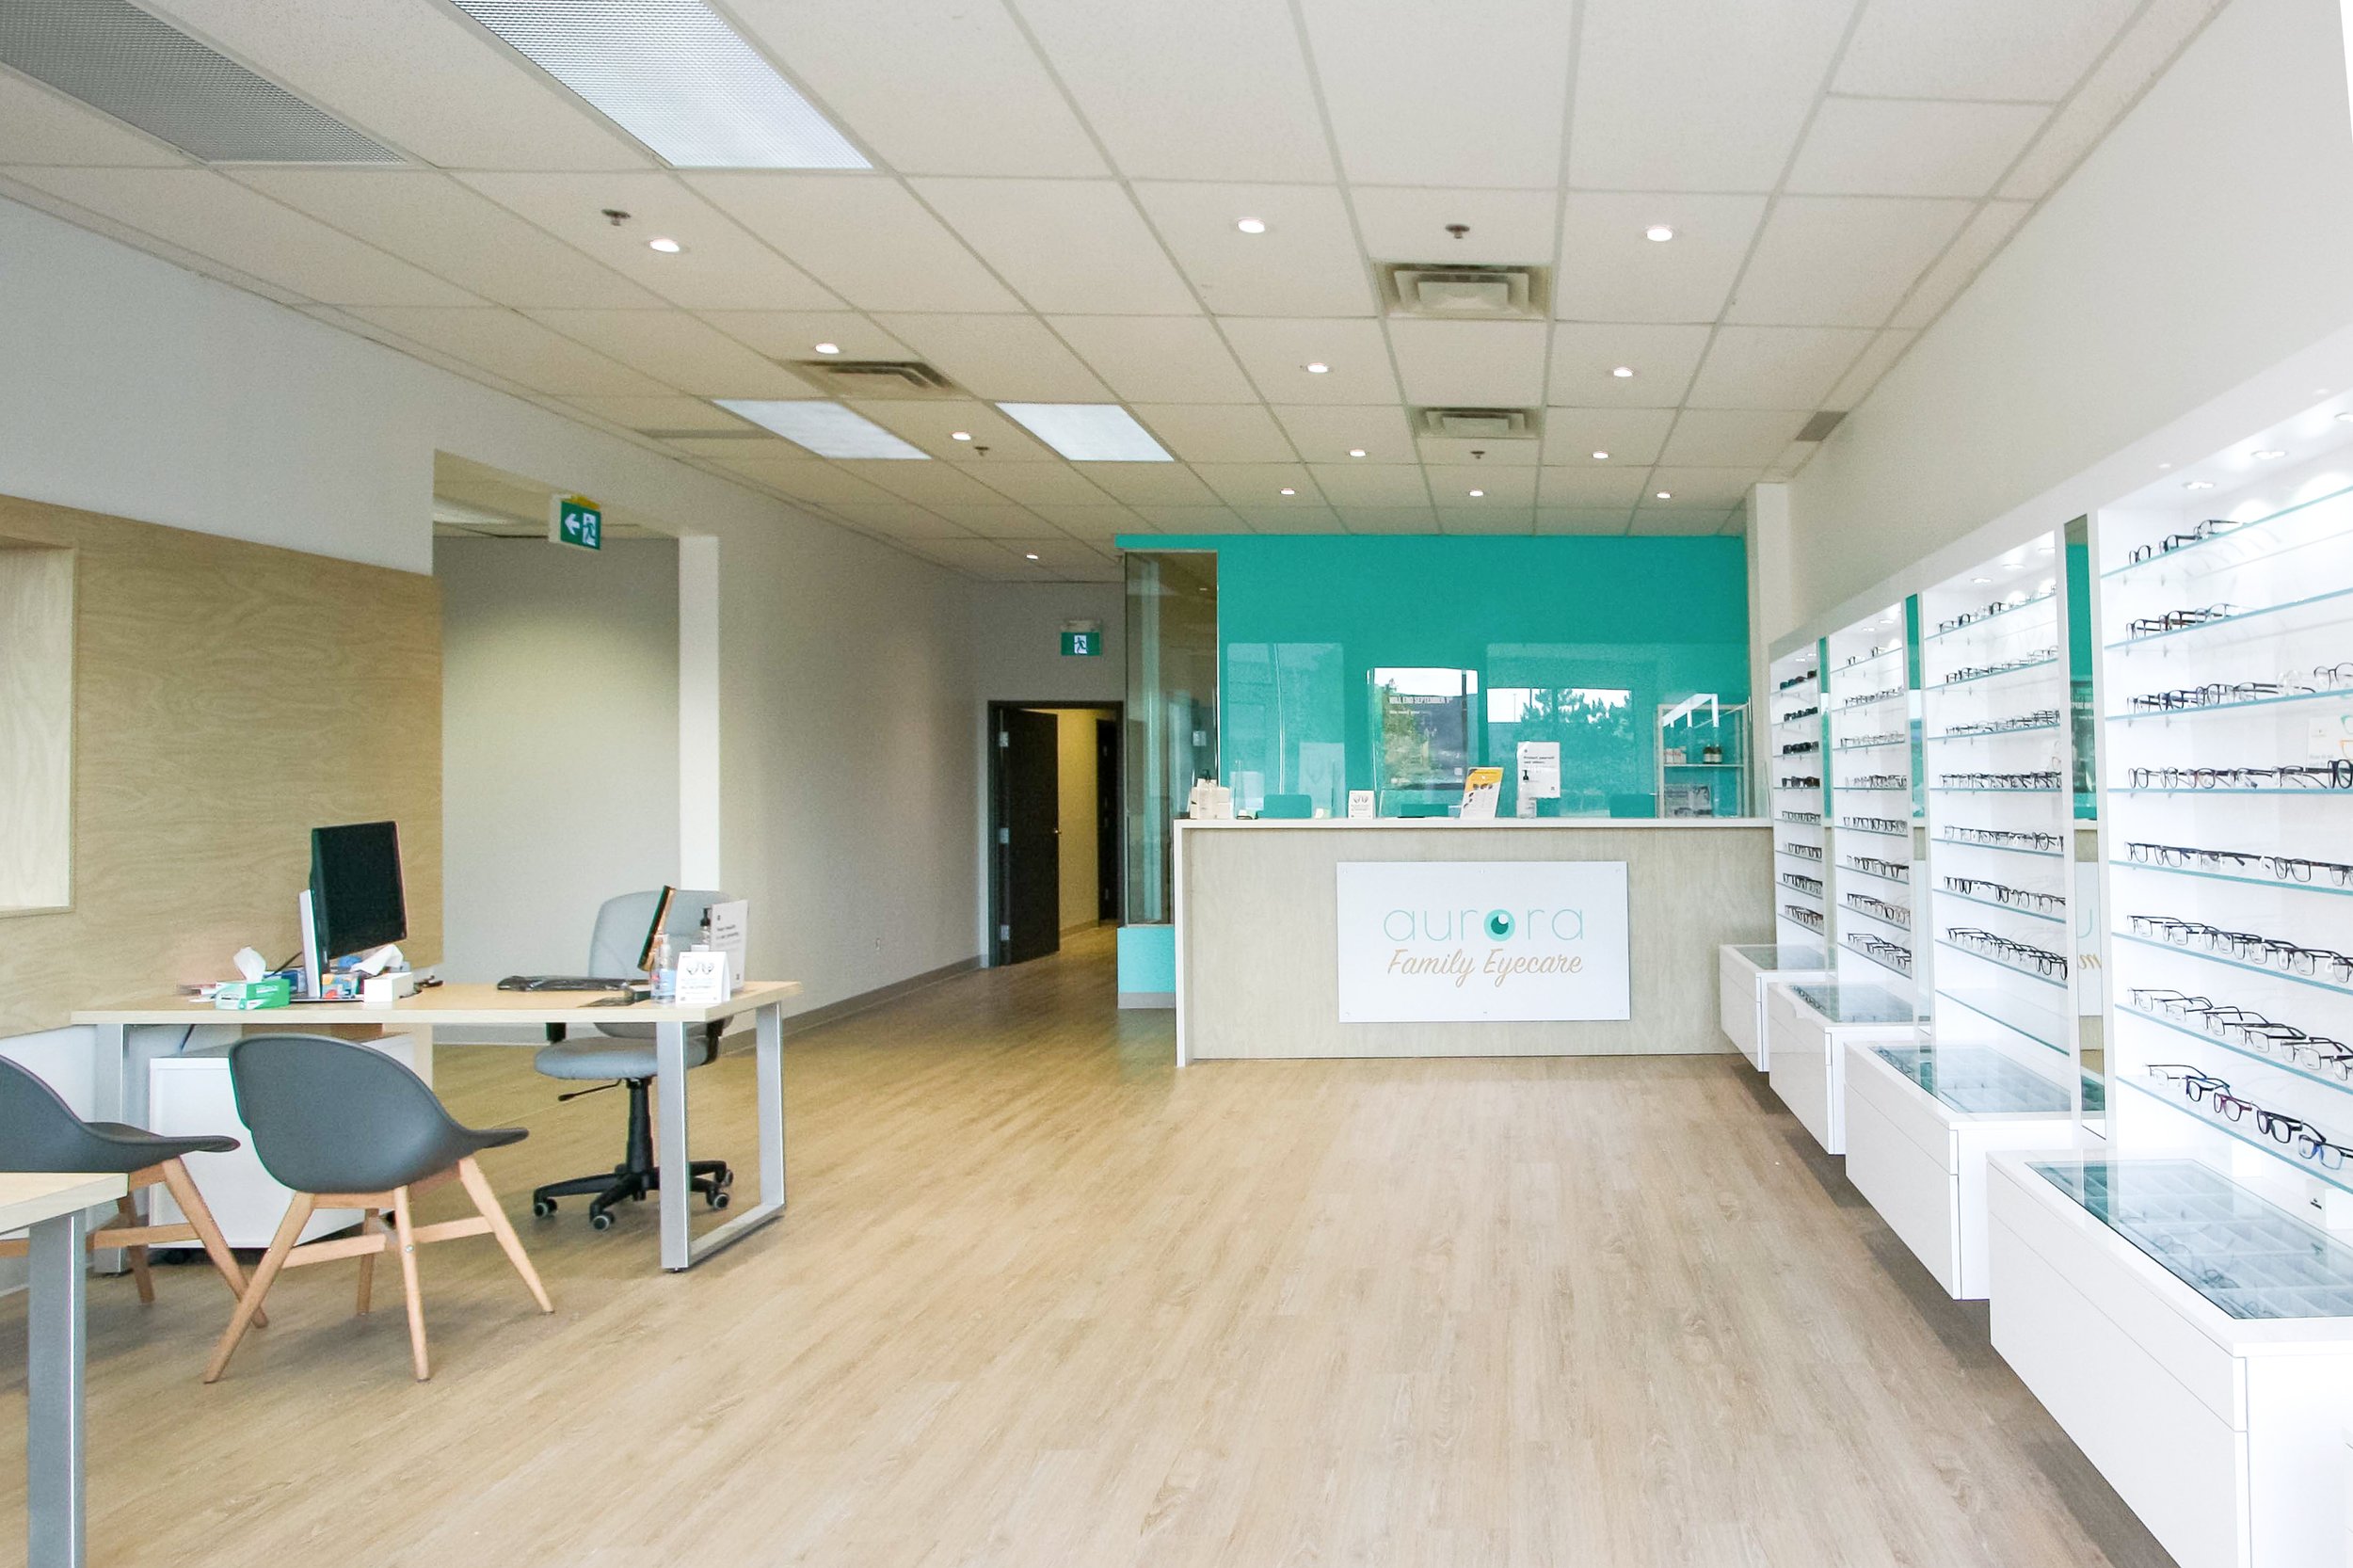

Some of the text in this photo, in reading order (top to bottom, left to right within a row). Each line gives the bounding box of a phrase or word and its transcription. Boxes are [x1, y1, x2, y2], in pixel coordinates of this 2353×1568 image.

[1384, 908, 1583, 942] aurora
[1387, 948, 1583, 988] Family Eyecare
